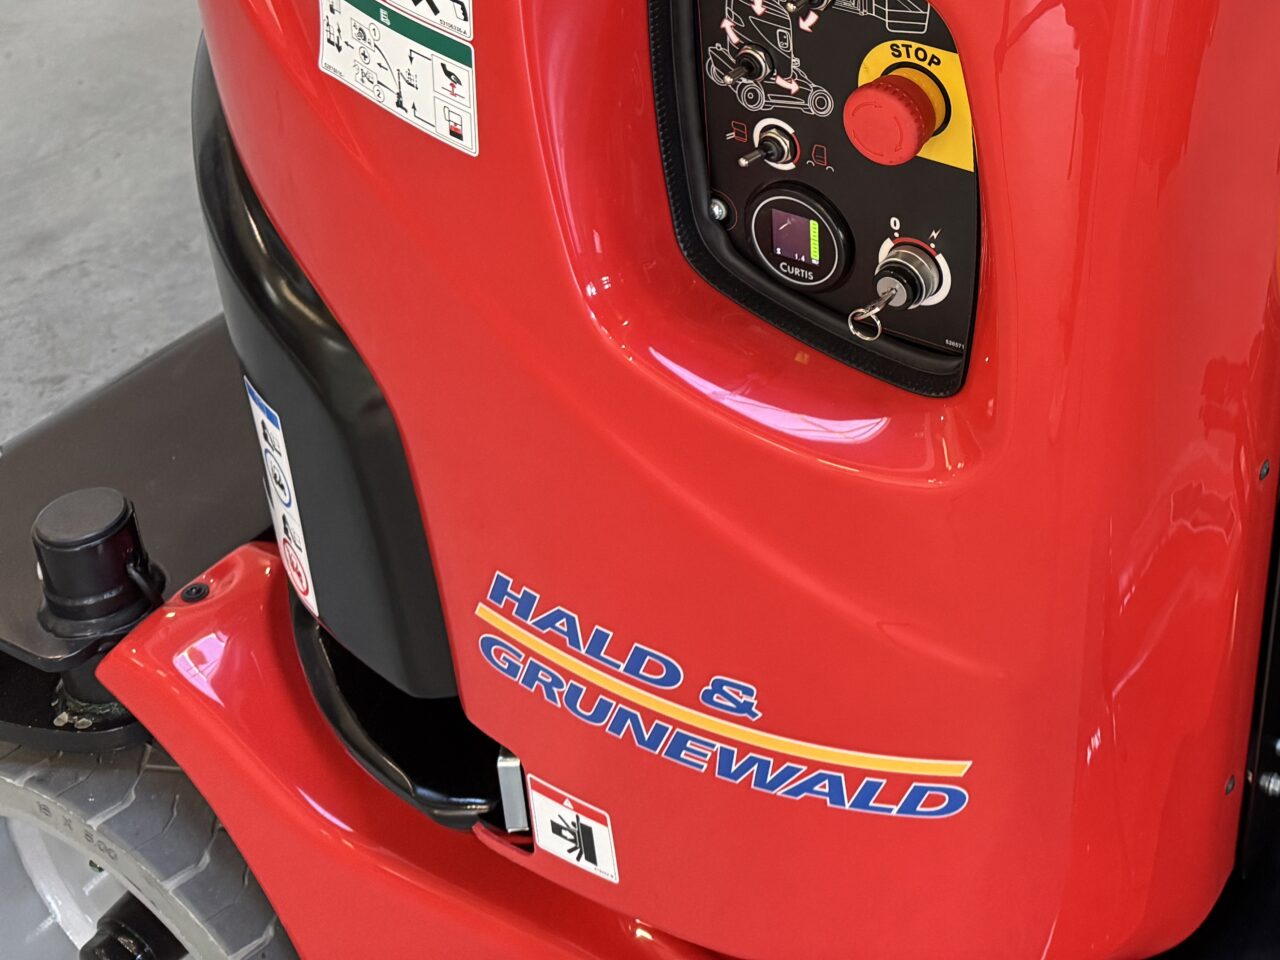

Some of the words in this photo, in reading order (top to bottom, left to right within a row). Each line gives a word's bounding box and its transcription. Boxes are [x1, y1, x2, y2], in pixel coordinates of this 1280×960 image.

[889, 43, 942, 67] STOP
[779, 261, 815, 280] CURTIS
[486, 570, 684, 691] HALD
[698, 675, 763, 722] &
[478, 633, 970, 820] GRUNEWALD
